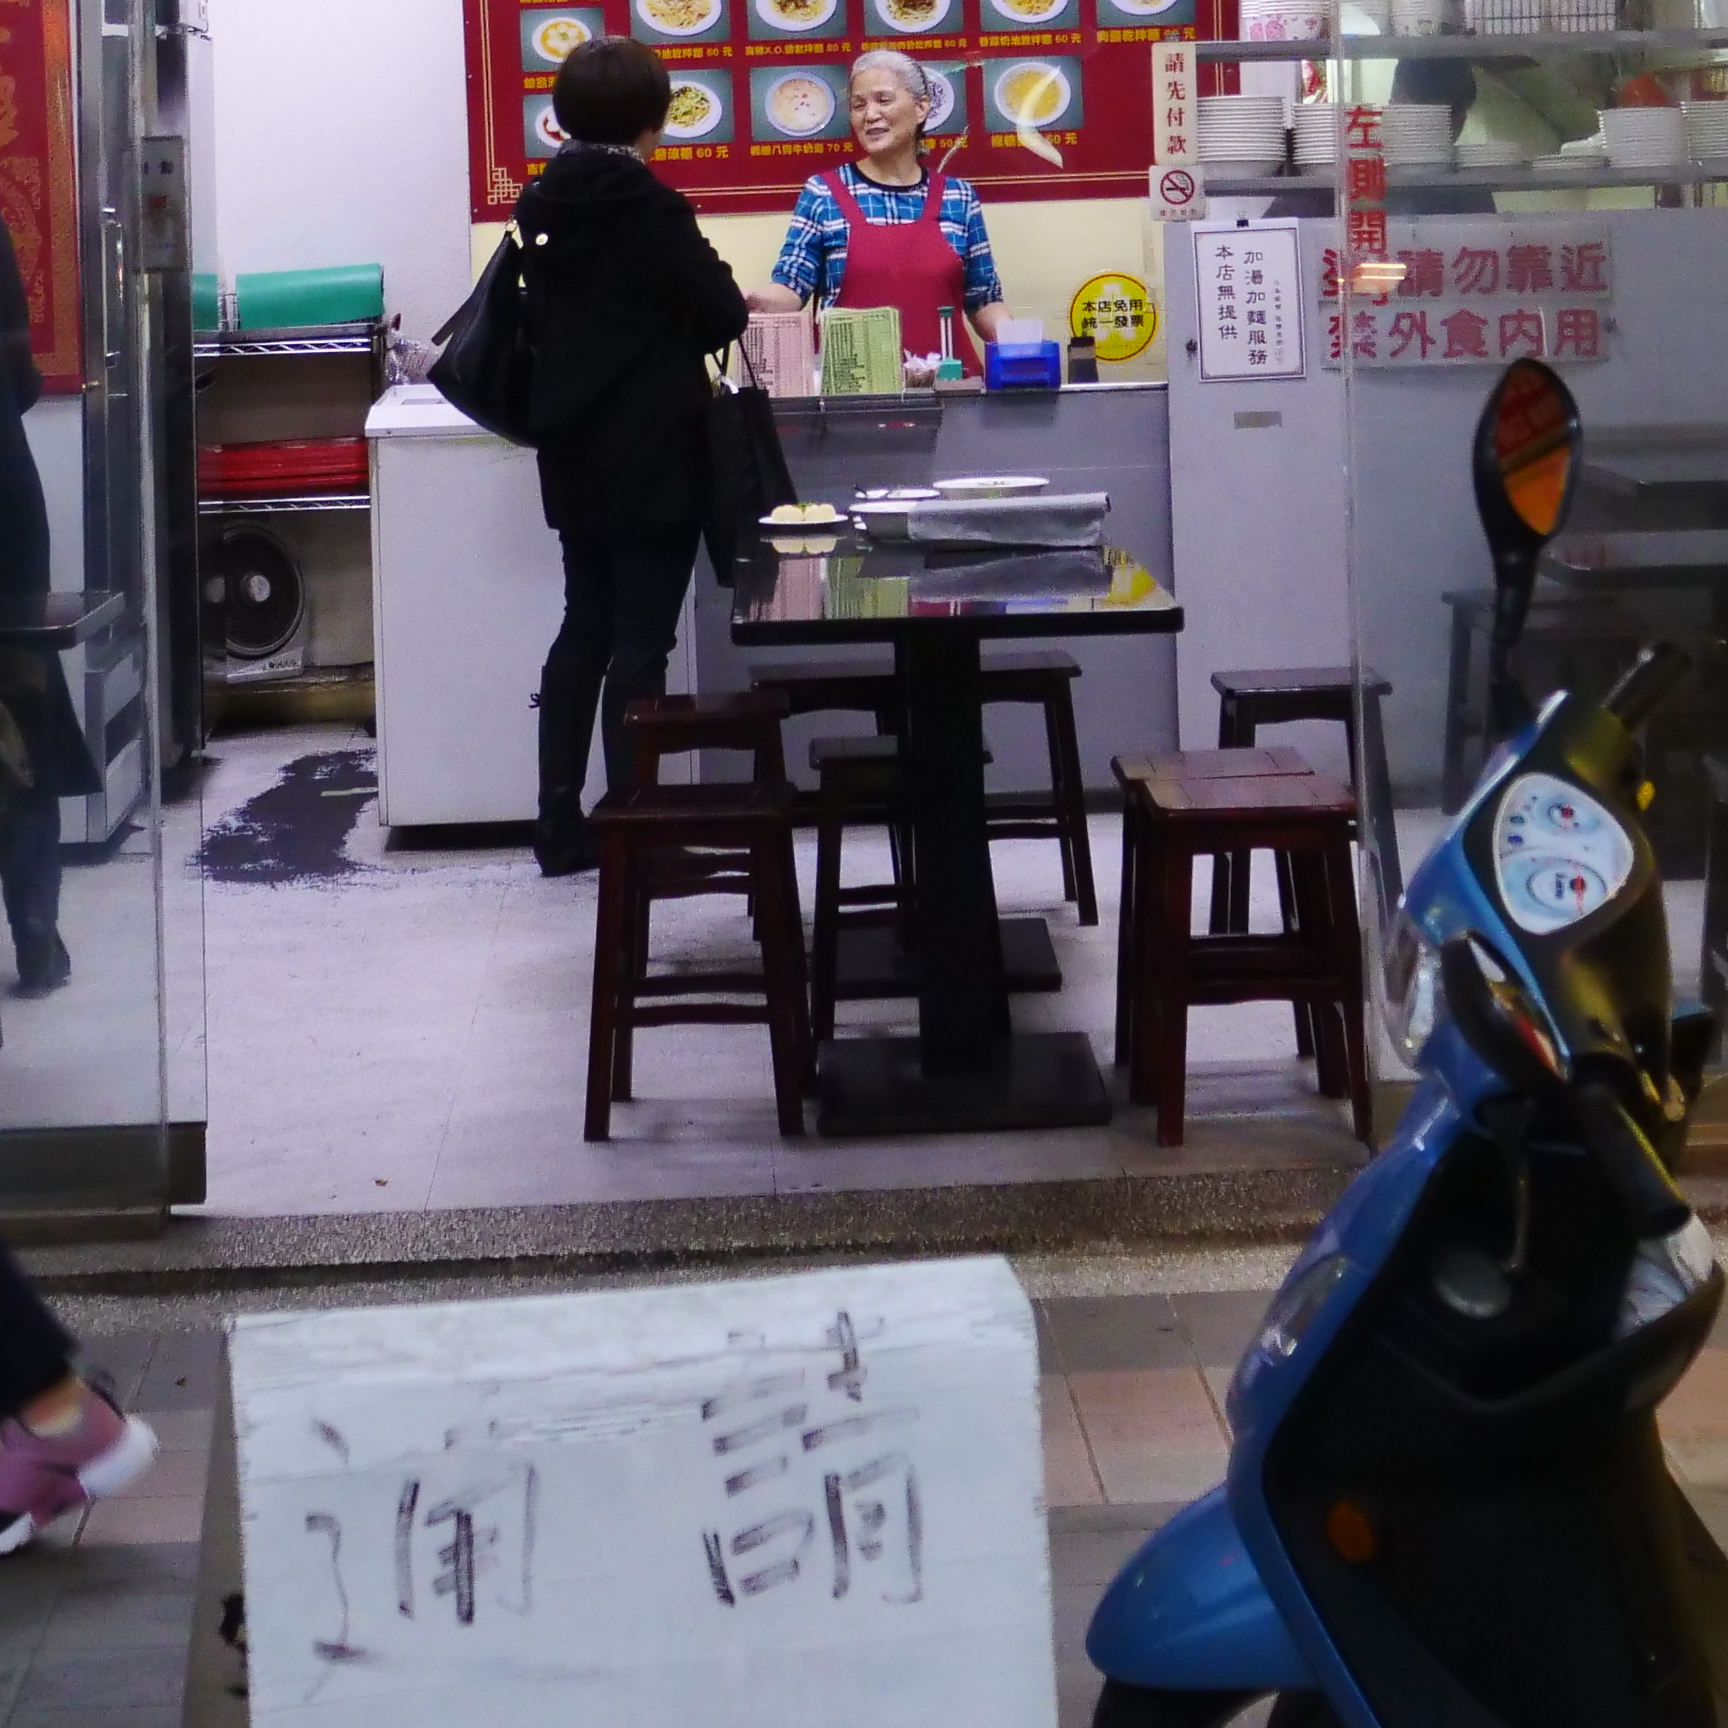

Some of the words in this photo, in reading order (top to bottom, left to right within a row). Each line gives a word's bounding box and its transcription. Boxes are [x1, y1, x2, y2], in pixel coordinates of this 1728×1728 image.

[1071, 32, 1082, 44] 元
[1184, 27, 1195, 40] 元
[841, 42, 851, 52] 元
[958, 38, 967, 48] 元
[722, 46, 733, 57] 元
[1164, 52, 1187, 155] 請先付款
[955, 135, 968, 148] 元
[1065, 132, 1077, 145] 元
[715, 145, 729, 159] 元
[843, 142, 853, 152] 元
[1344, 105, 1387, 306] 左側開
[1215, 245, 1238, 340] 本店無提供
[1081, 298, 1144, 313] 本店免用
[1243, 251, 1268, 365] 加湯加麵服務
[1081, 315, 1145, 330] 統一發票
